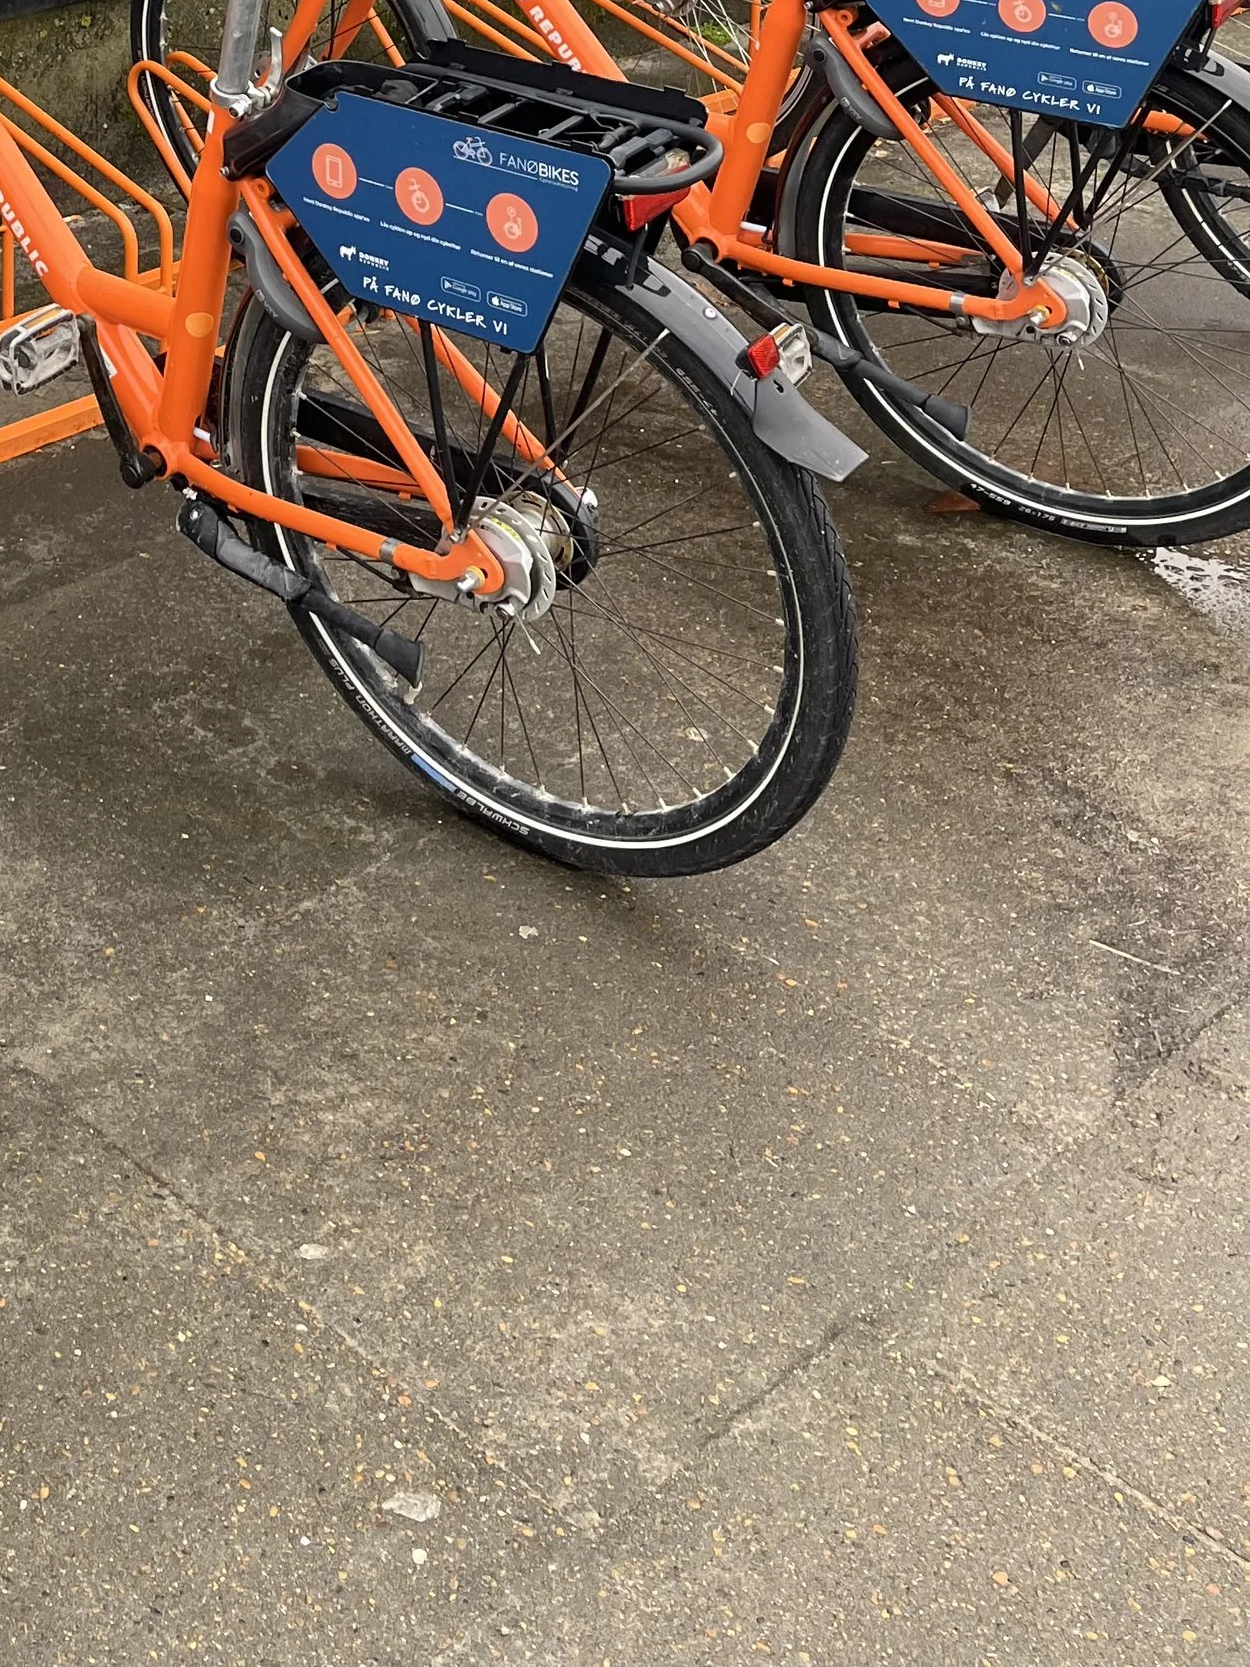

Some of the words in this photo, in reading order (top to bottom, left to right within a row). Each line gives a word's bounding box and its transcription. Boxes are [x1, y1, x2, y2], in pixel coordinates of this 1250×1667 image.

[529, 5, 586, 72] REPUB
[957, 57, 987, 68] DONKEY
[959, 76, 975, 90] PÅ
[980, 81, 1016, 97] FANØ
[1022, 90, 1080, 111] CYKLER
[1086, 103, 1101, 115] VI
[499, 152, 579, 186] FANØBIKES
[359, 251, 389, 266] DONKEY
[363, 276, 379, 293] PÅ
[384, 285, 421, 306] FANØ
[427, 299, 487, 329] CYKLER
[493, 320, 508, 336] VI
[329, 658, 355, 691] PLUS
[355, 695, 412, 755] MARATHON
[457, 790, 530, 836] SCHWALBE
